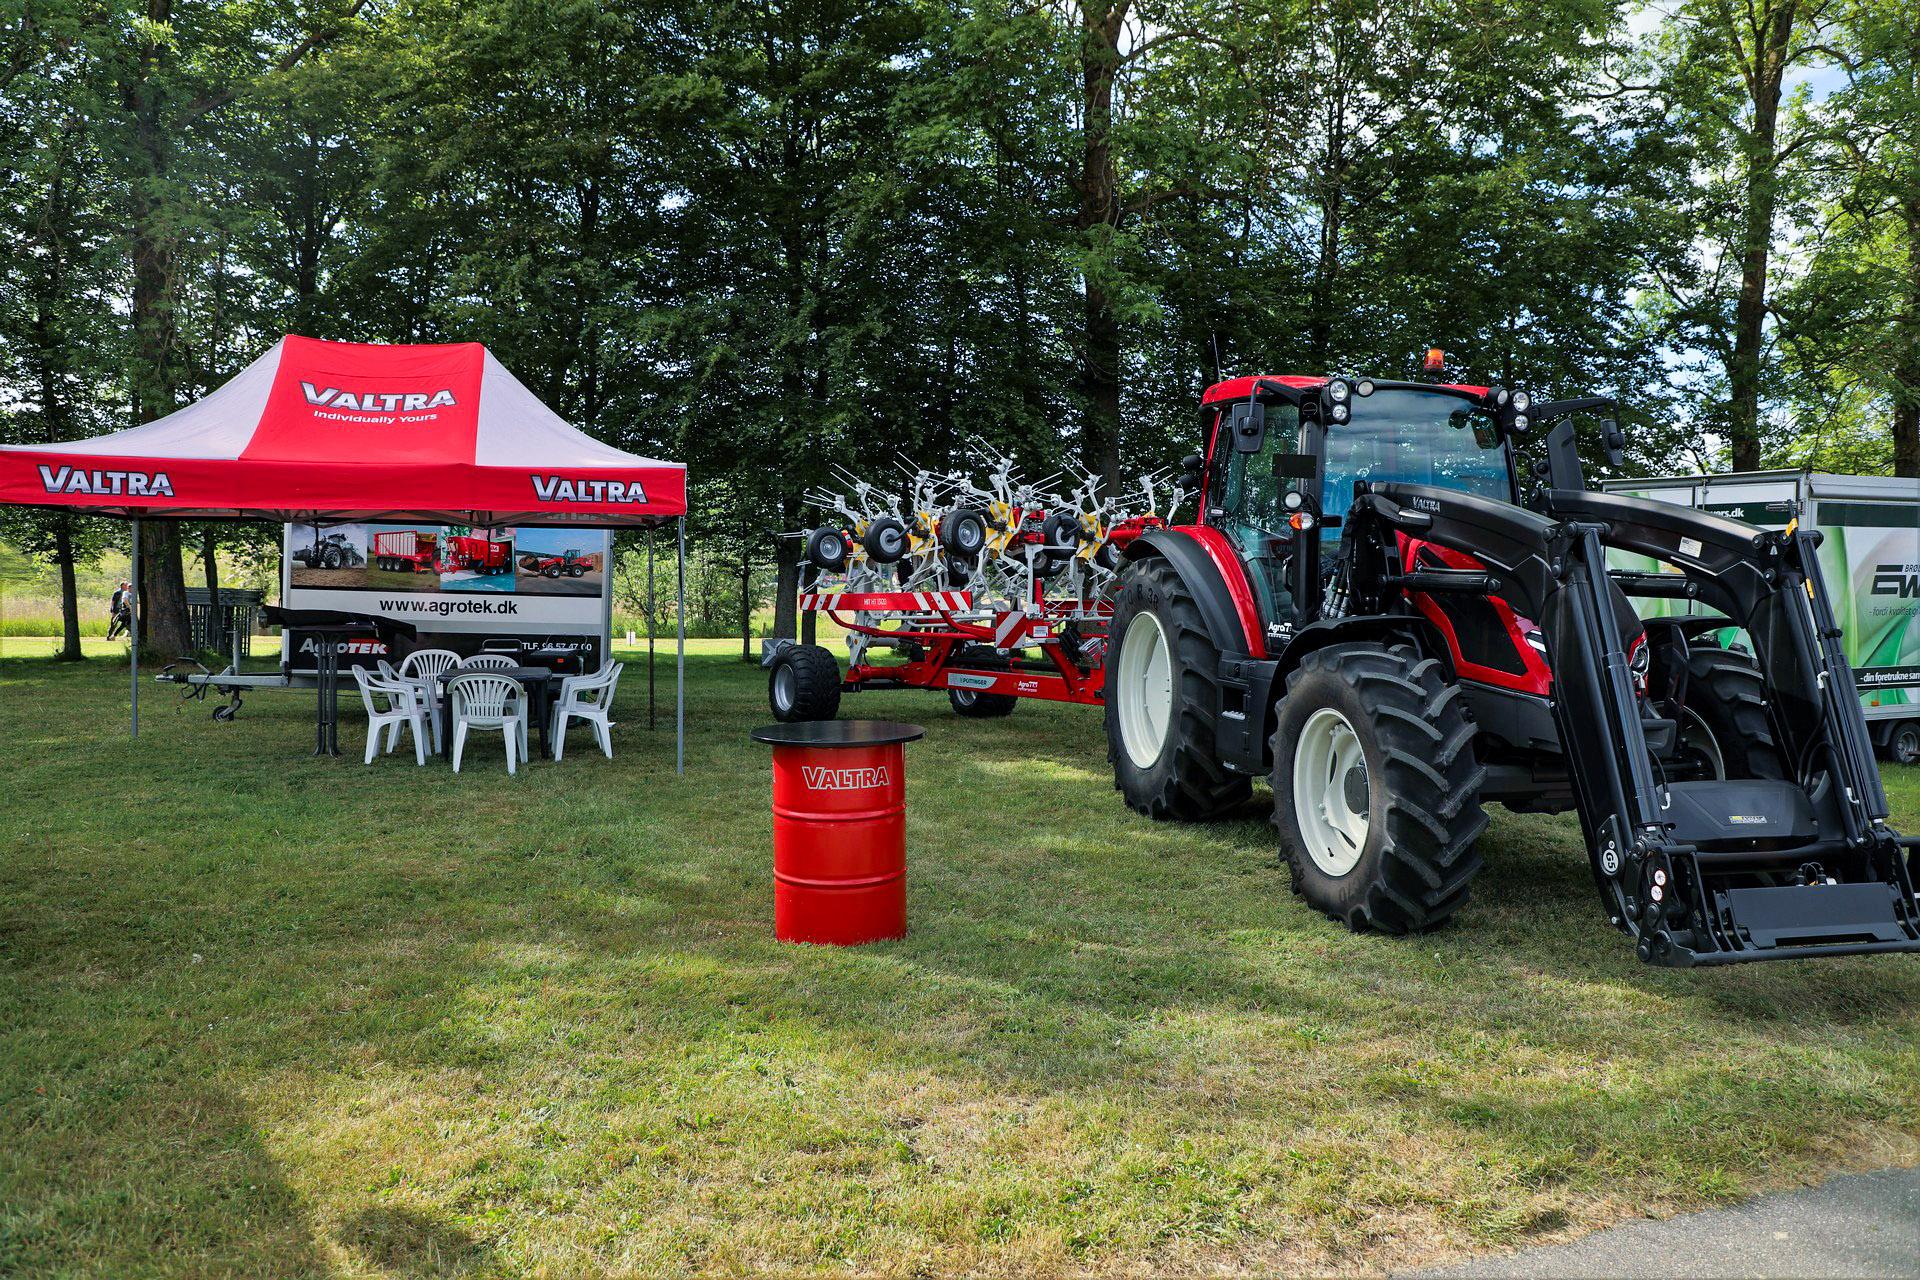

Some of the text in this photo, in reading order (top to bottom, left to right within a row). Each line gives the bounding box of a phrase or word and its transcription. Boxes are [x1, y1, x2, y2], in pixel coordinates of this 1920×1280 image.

[301, 381, 457, 412] VALTRA
[314, 410, 437, 425] Individually Yours
[37, 464, 175, 497] VALTRA
[530, 474, 649, 504] VALTRA
[1412, 496, 1441, 512] VALTRA
[379, 599, 518, 616] www.agrotek.dk
[522, 642, 540, 650] TLF.
[1875, 671, 1909, 681] foretrukne
[801, 765, 891, 790] VALTRA
[1606, 851, 1617, 873] G5
